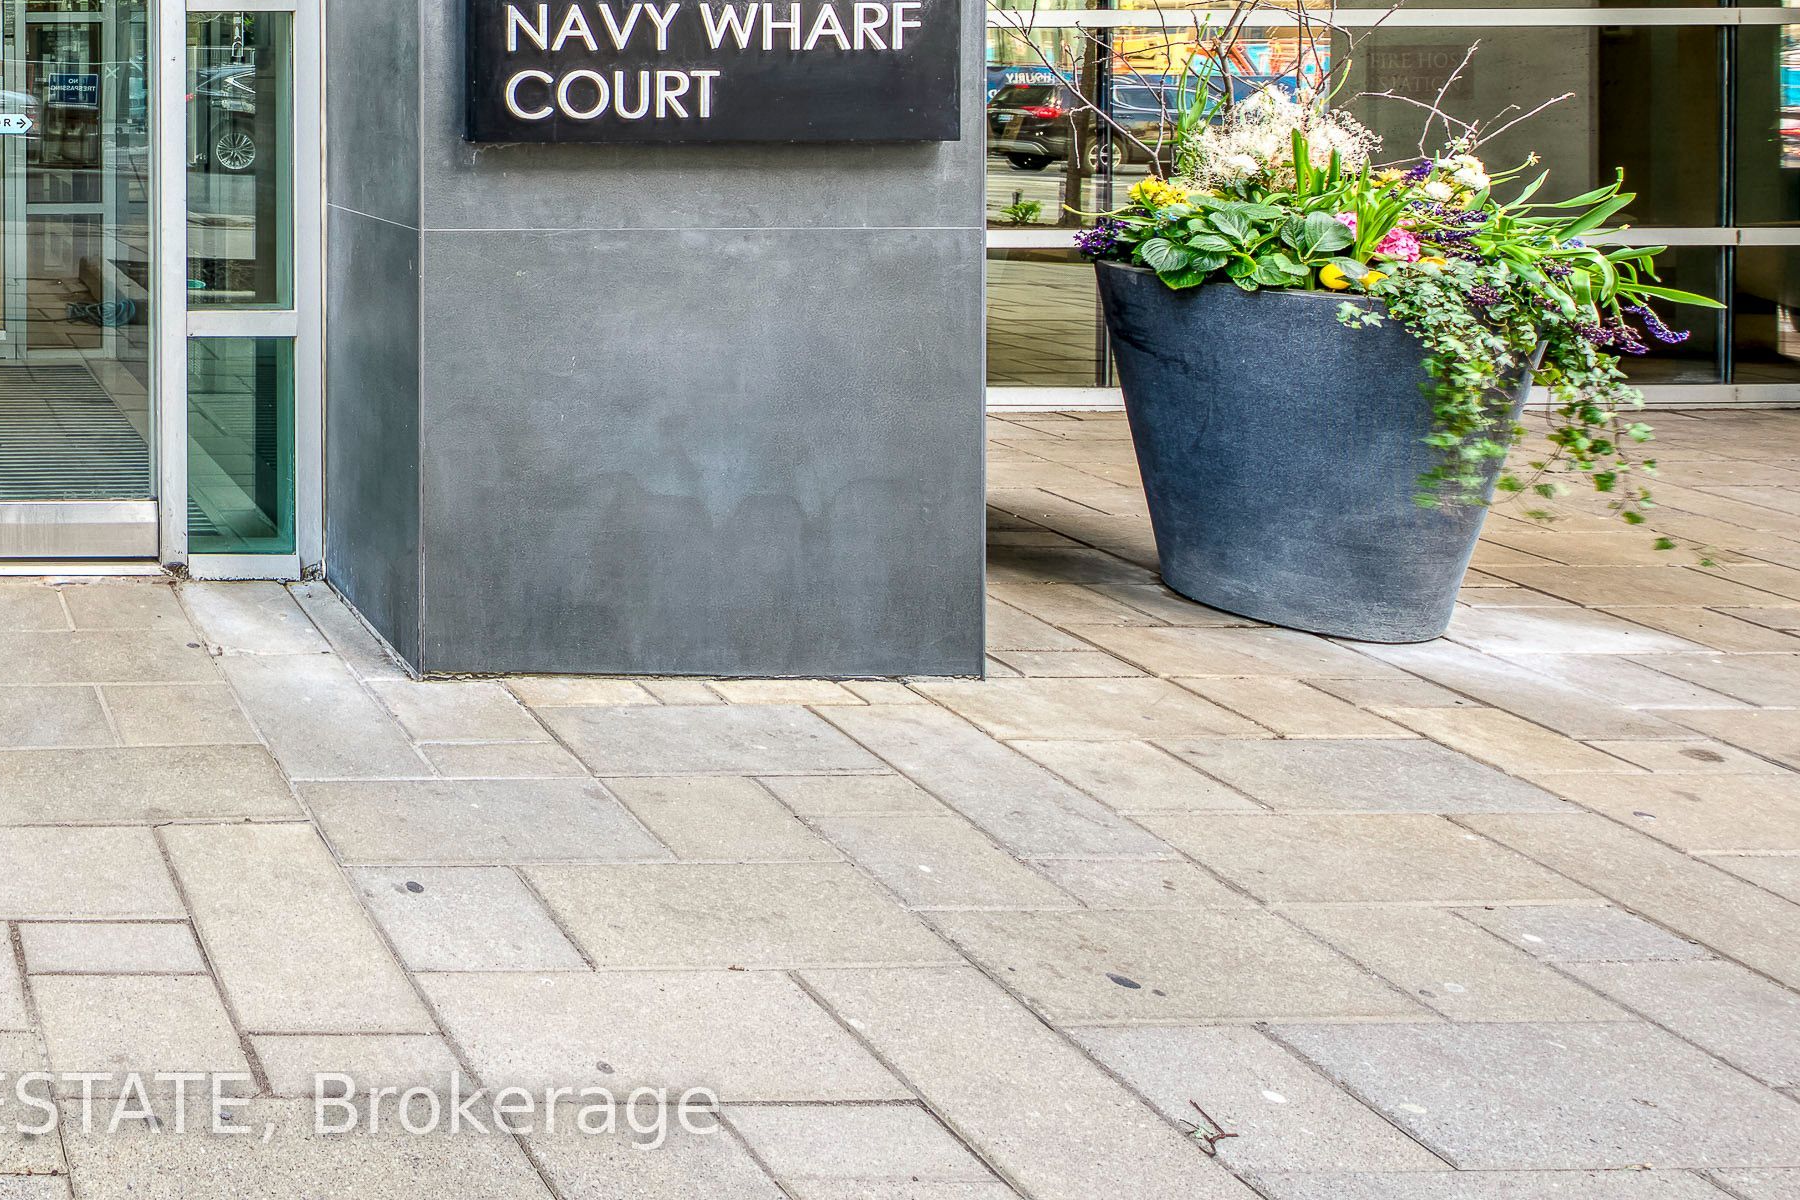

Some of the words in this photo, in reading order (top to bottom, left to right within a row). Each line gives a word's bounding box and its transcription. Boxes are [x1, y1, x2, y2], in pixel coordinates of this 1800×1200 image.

[505, 2, 681, 52] NAVY
[700, 2, 922, 52] WHARF
[1369, 52, 1412, 69] FIRE
[504, 69, 720, 120] COURT
